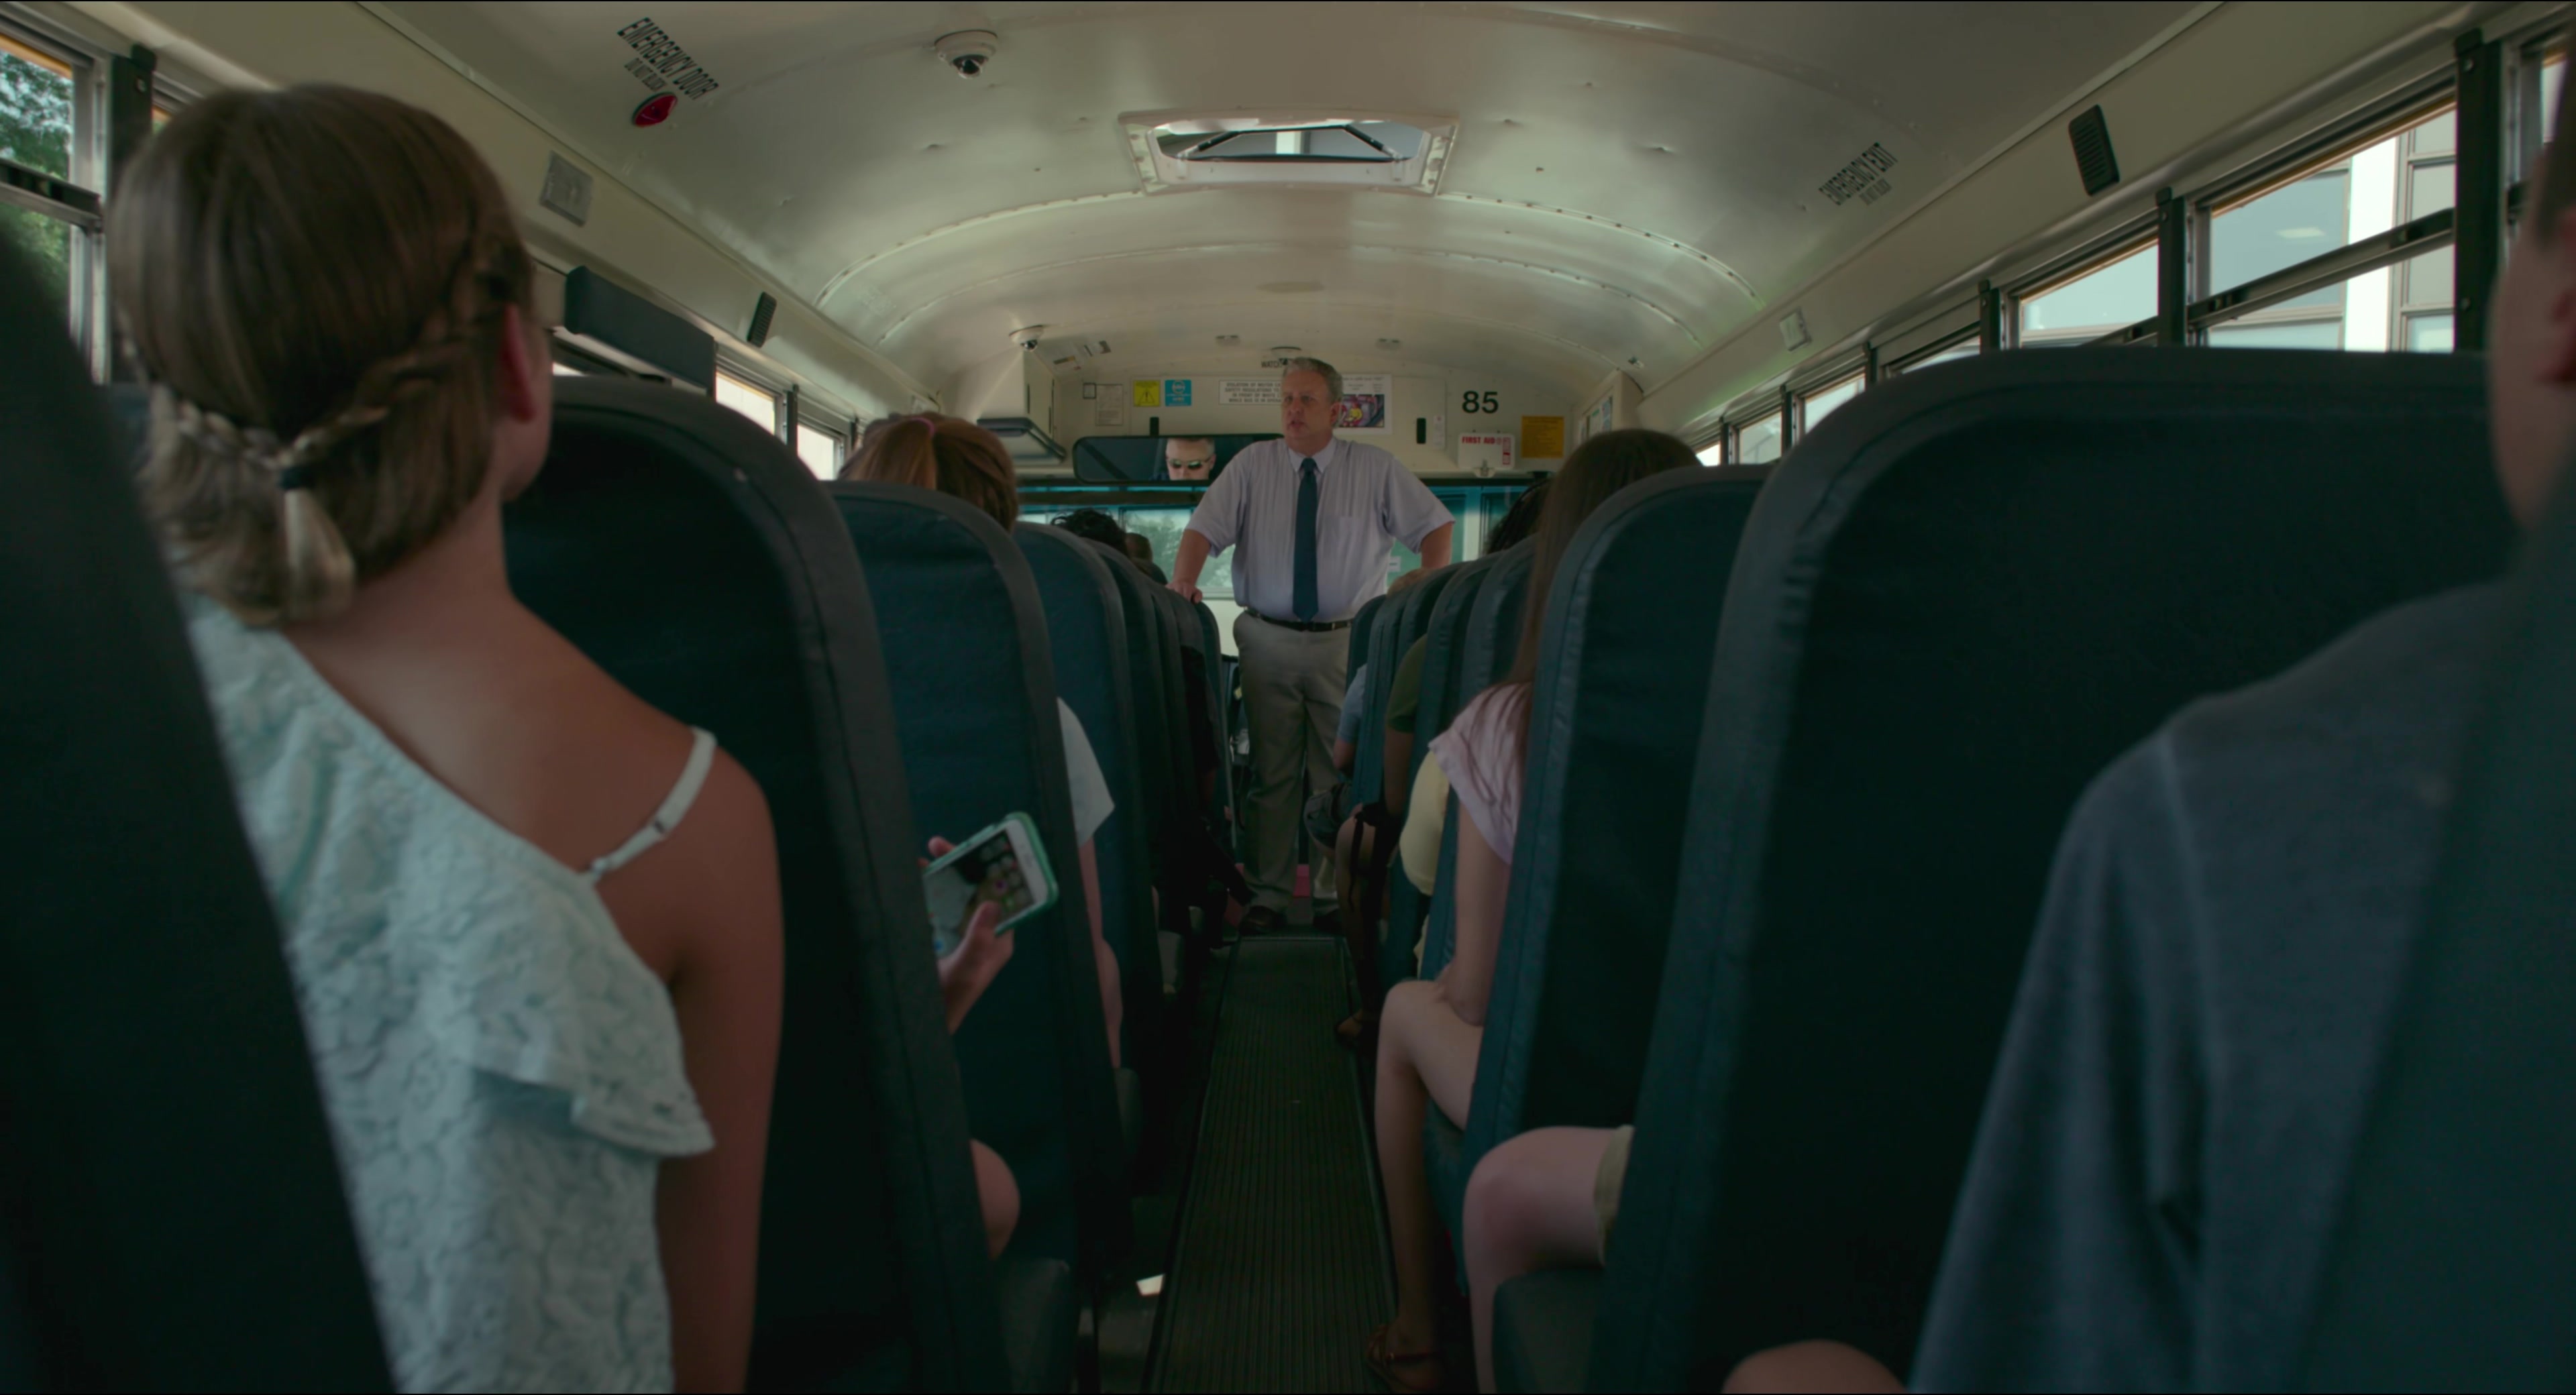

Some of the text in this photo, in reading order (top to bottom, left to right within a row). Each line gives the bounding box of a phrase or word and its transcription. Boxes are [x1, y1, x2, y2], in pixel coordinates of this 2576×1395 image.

[617, 17, 698, 78] EMERGENCY
[672, 67, 719, 100] DOOR
[1818, 156, 1880, 206] EMERGENCY
[1862, 142, 1898, 172] EXIT
[1462, 390, 1499, 413] 85
[1462, 436, 1481, 444] FIRST
